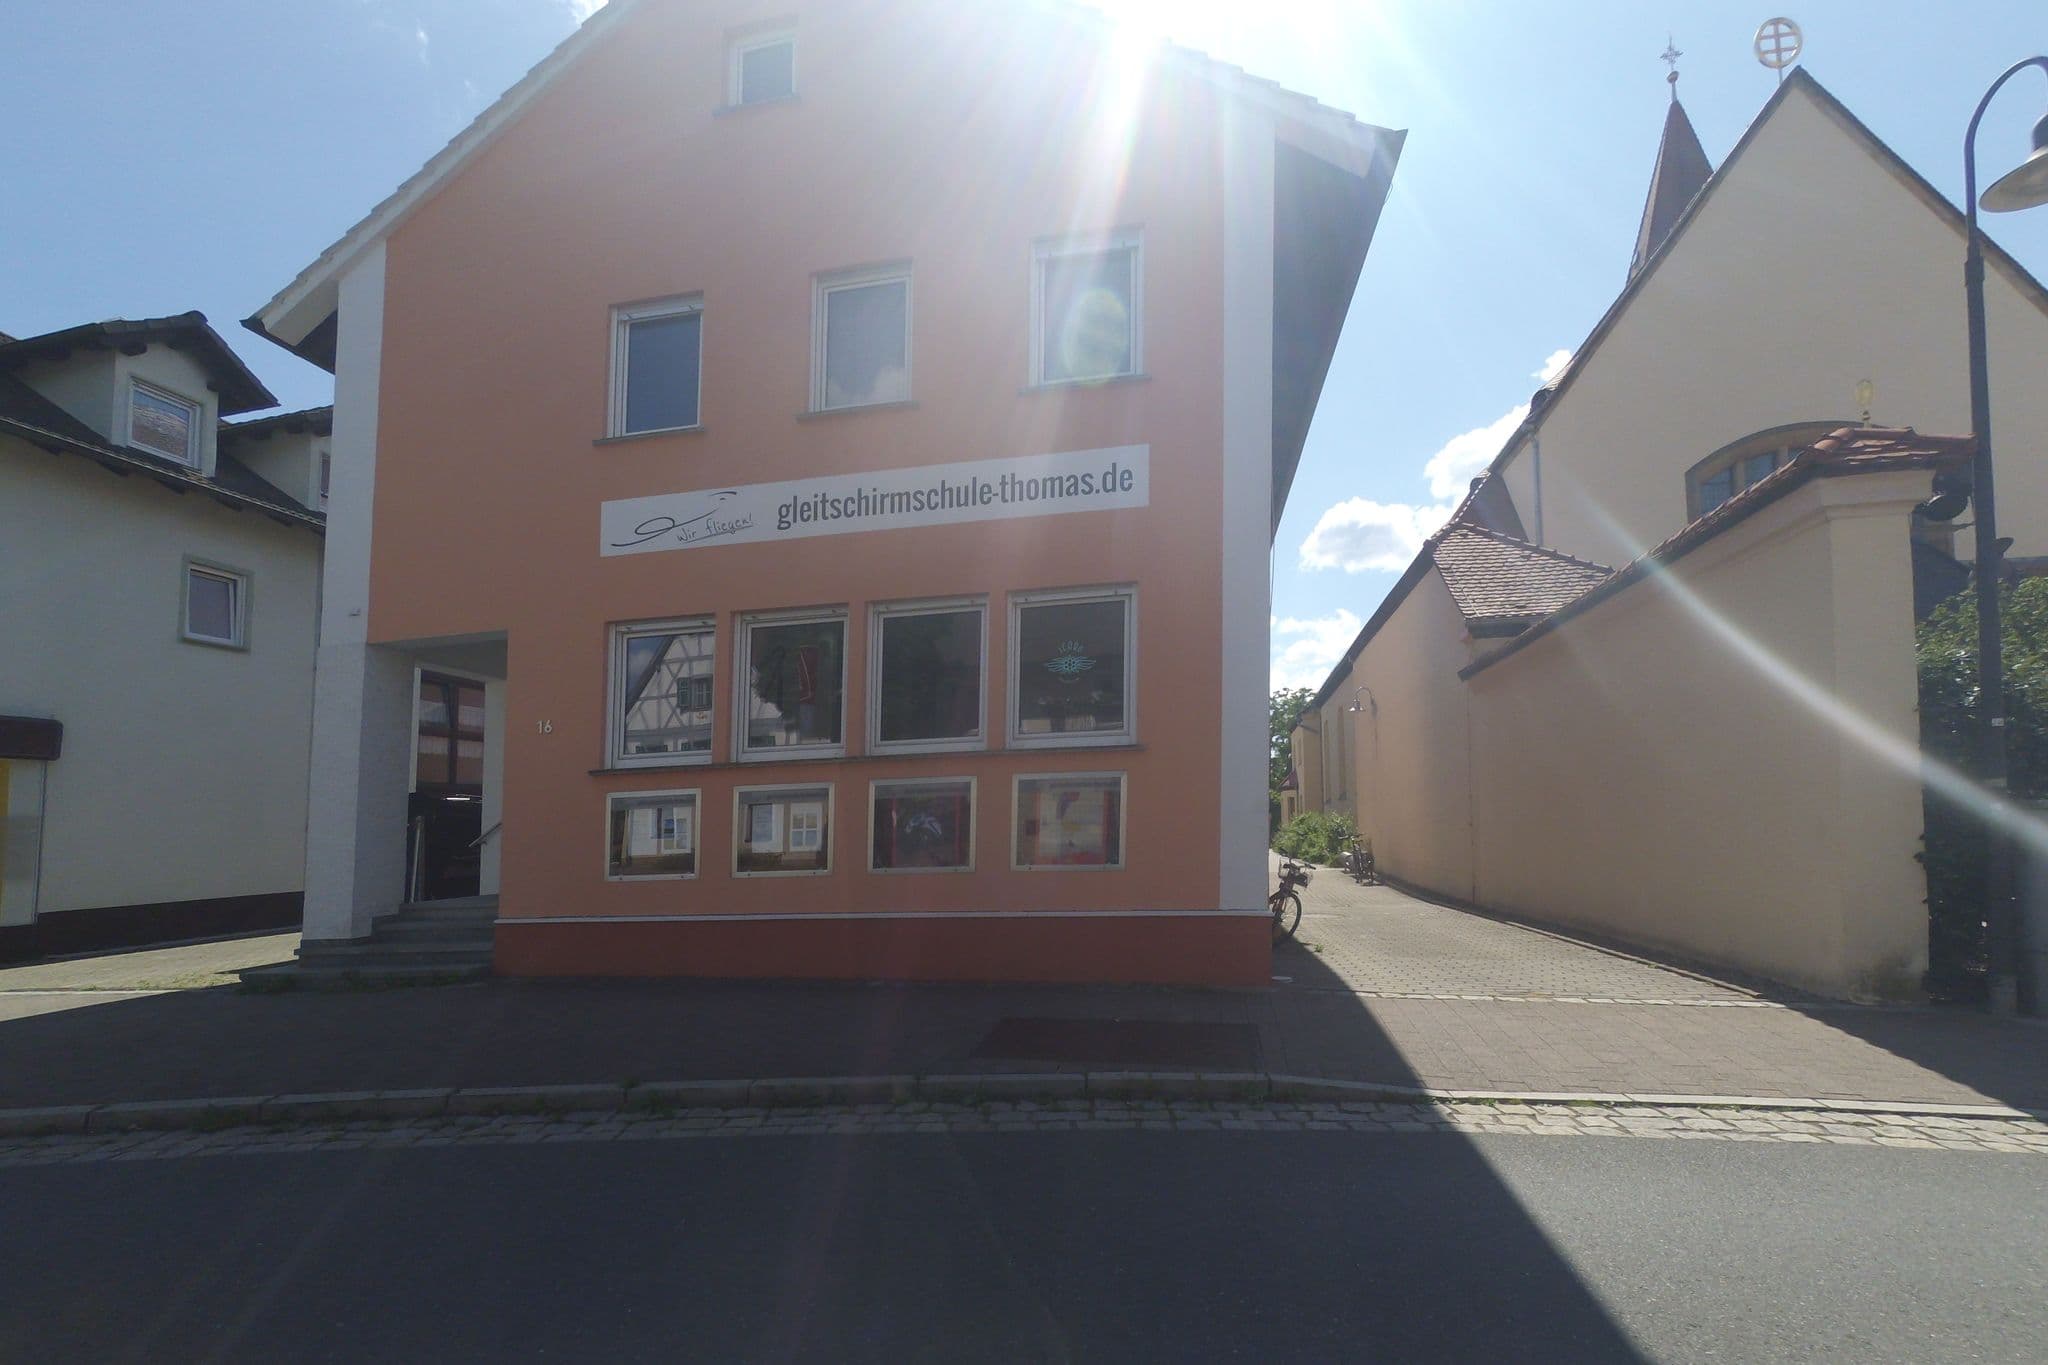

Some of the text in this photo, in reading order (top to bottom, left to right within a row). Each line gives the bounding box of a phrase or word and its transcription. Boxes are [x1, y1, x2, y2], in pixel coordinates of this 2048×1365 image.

[776, 462, 1134, 531] gleitschirmschule-thomas.de
[676, 527, 697, 542] Wir
[536, 719, 553, 735] 16
